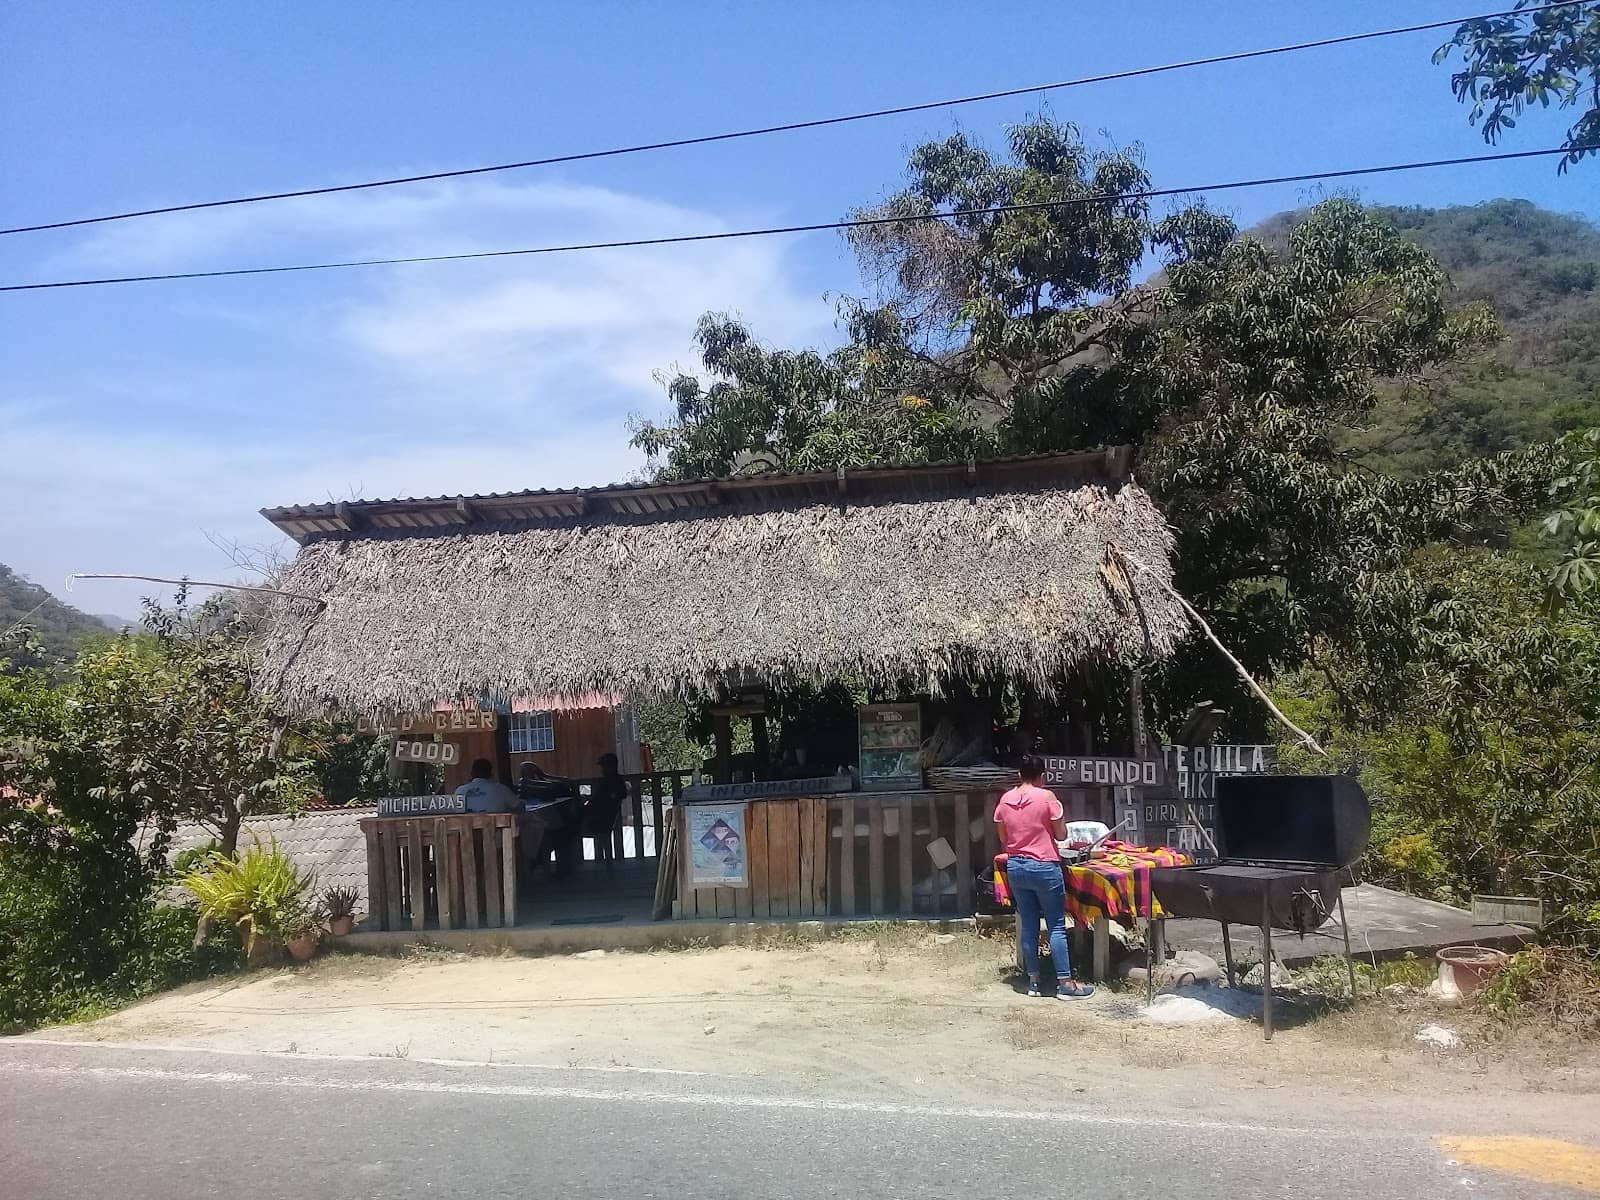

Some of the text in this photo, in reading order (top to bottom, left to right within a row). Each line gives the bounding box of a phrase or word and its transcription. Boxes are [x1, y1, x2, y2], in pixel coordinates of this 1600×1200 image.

[436, 711, 493, 730] BEER
[395, 740, 454, 761] FOOD
[1161, 745, 1264, 773] TEQUILA
[1045, 758, 1076, 771] ICOR
[1080, 760, 1156, 785] GONDO
[1046, 772, 1063, 783] DE
[1178, 772, 1216, 799] HIKI
[378, 795, 465, 814] MICHELADAS
[1145, 804, 1177, 822] BIRD
